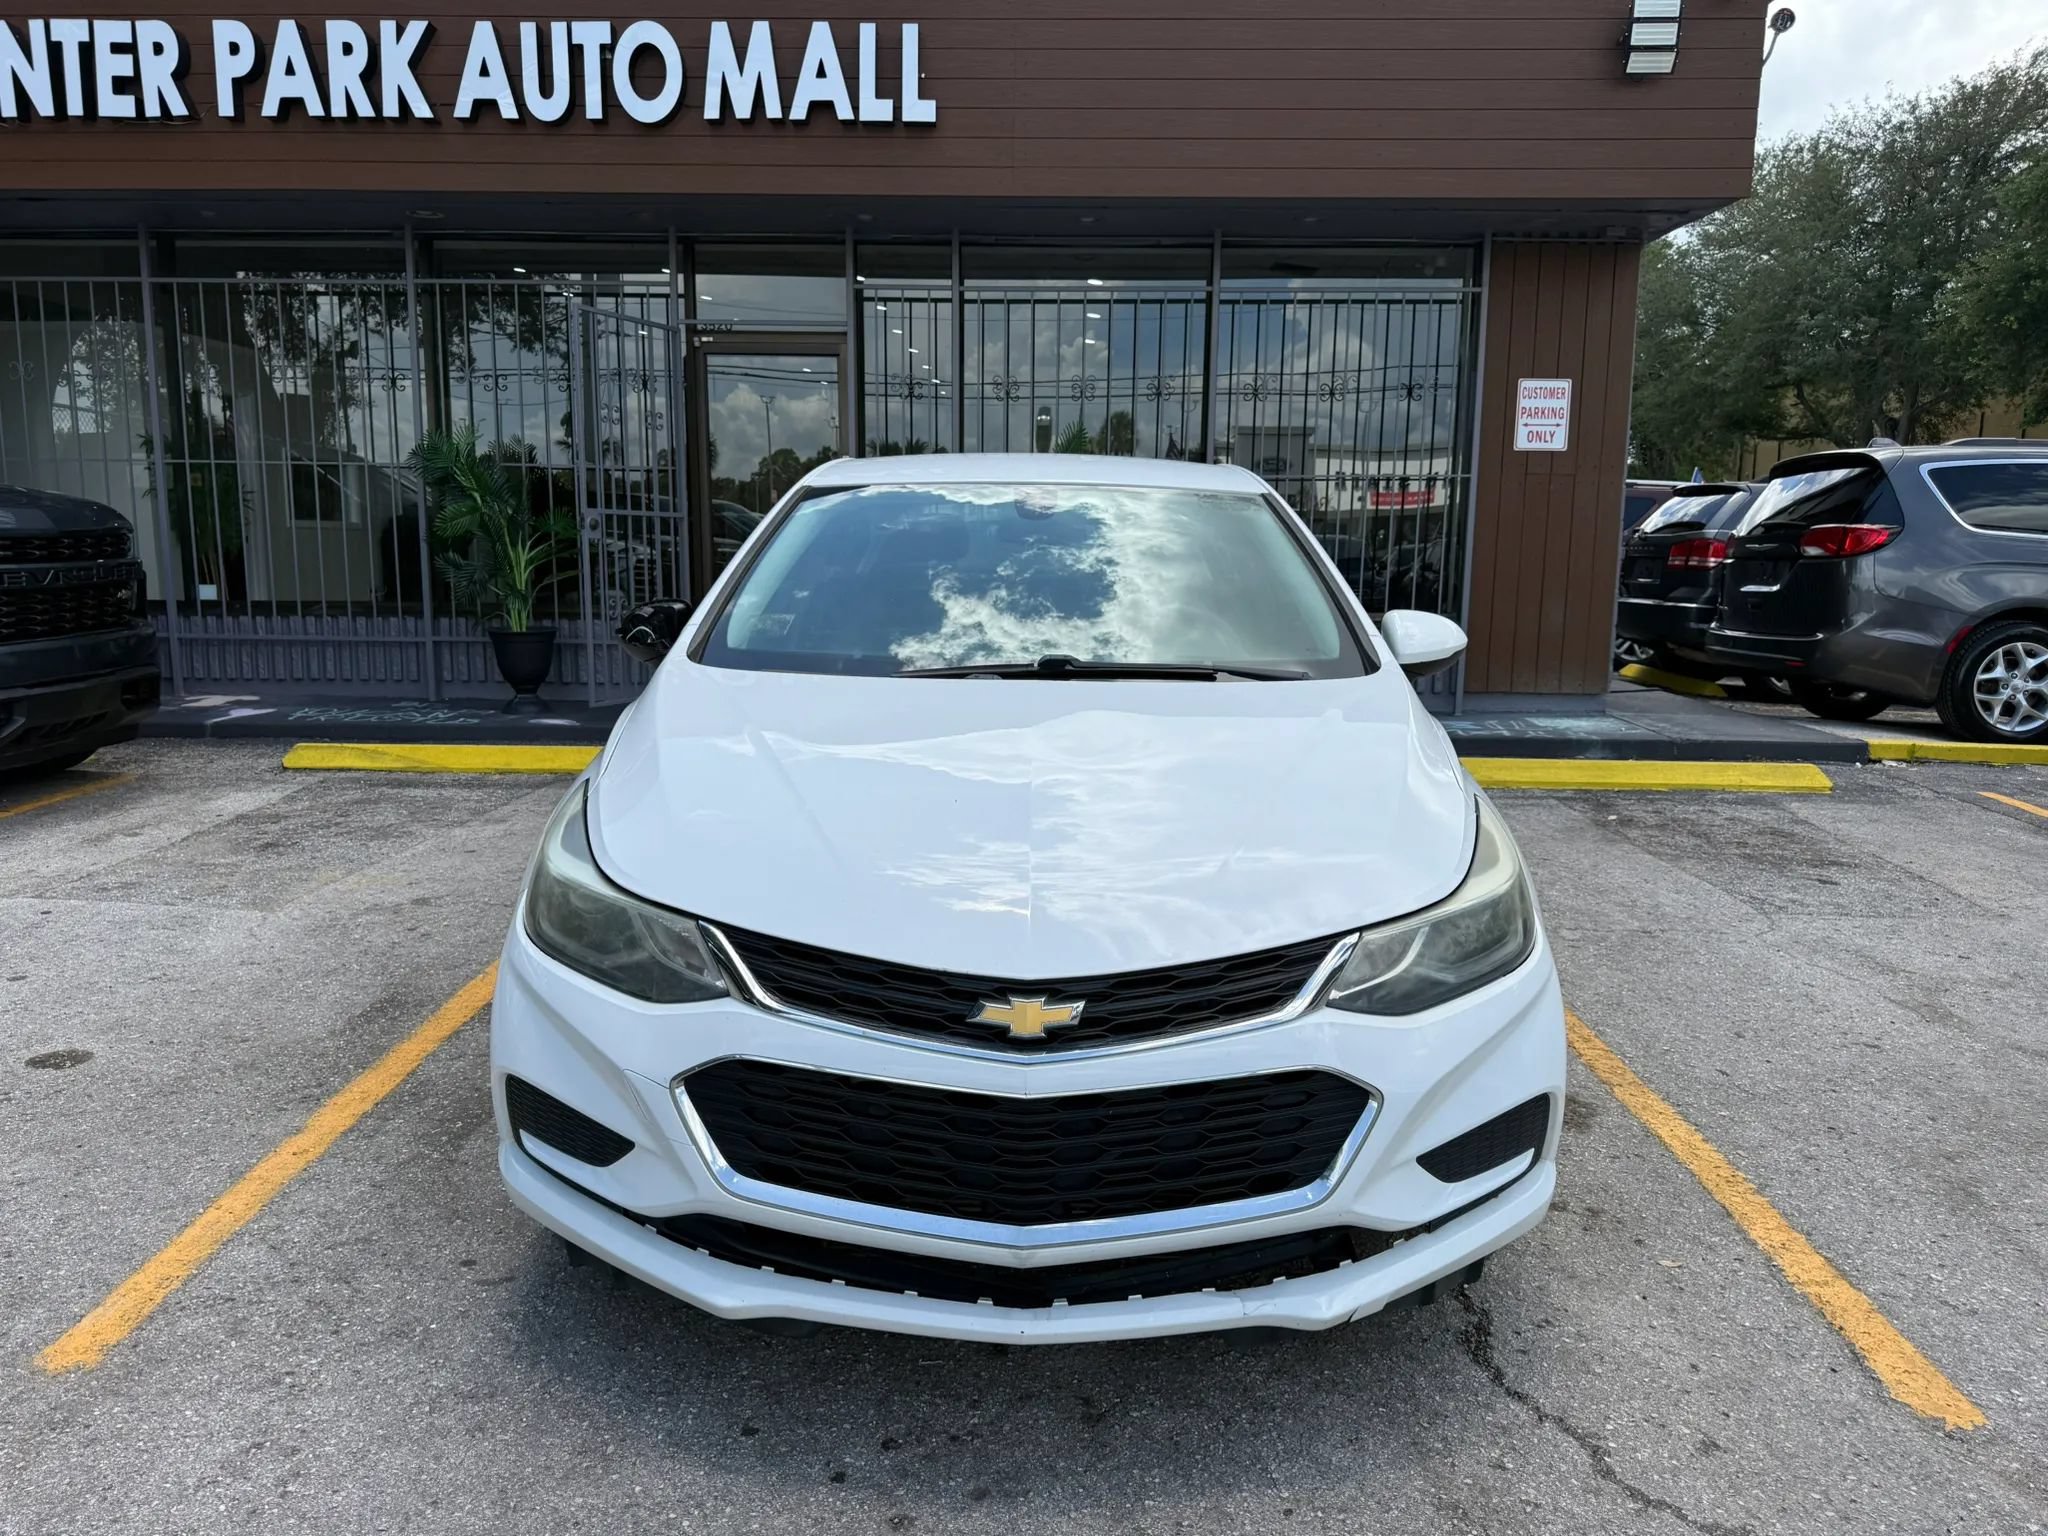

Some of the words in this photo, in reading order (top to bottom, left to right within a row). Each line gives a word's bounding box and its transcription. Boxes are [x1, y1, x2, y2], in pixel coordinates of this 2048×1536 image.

[0, 20, 188, 118] NTER
[213, 20, 435, 119] PARK
[454, 21, 684, 123] AUTO
[704, 21, 937, 123] MALL
[1522, 386, 1566, 399] CUSTOMER
[1521, 406, 1564, 419] PARKING
[1527, 430, 1556, 443] ONLY
